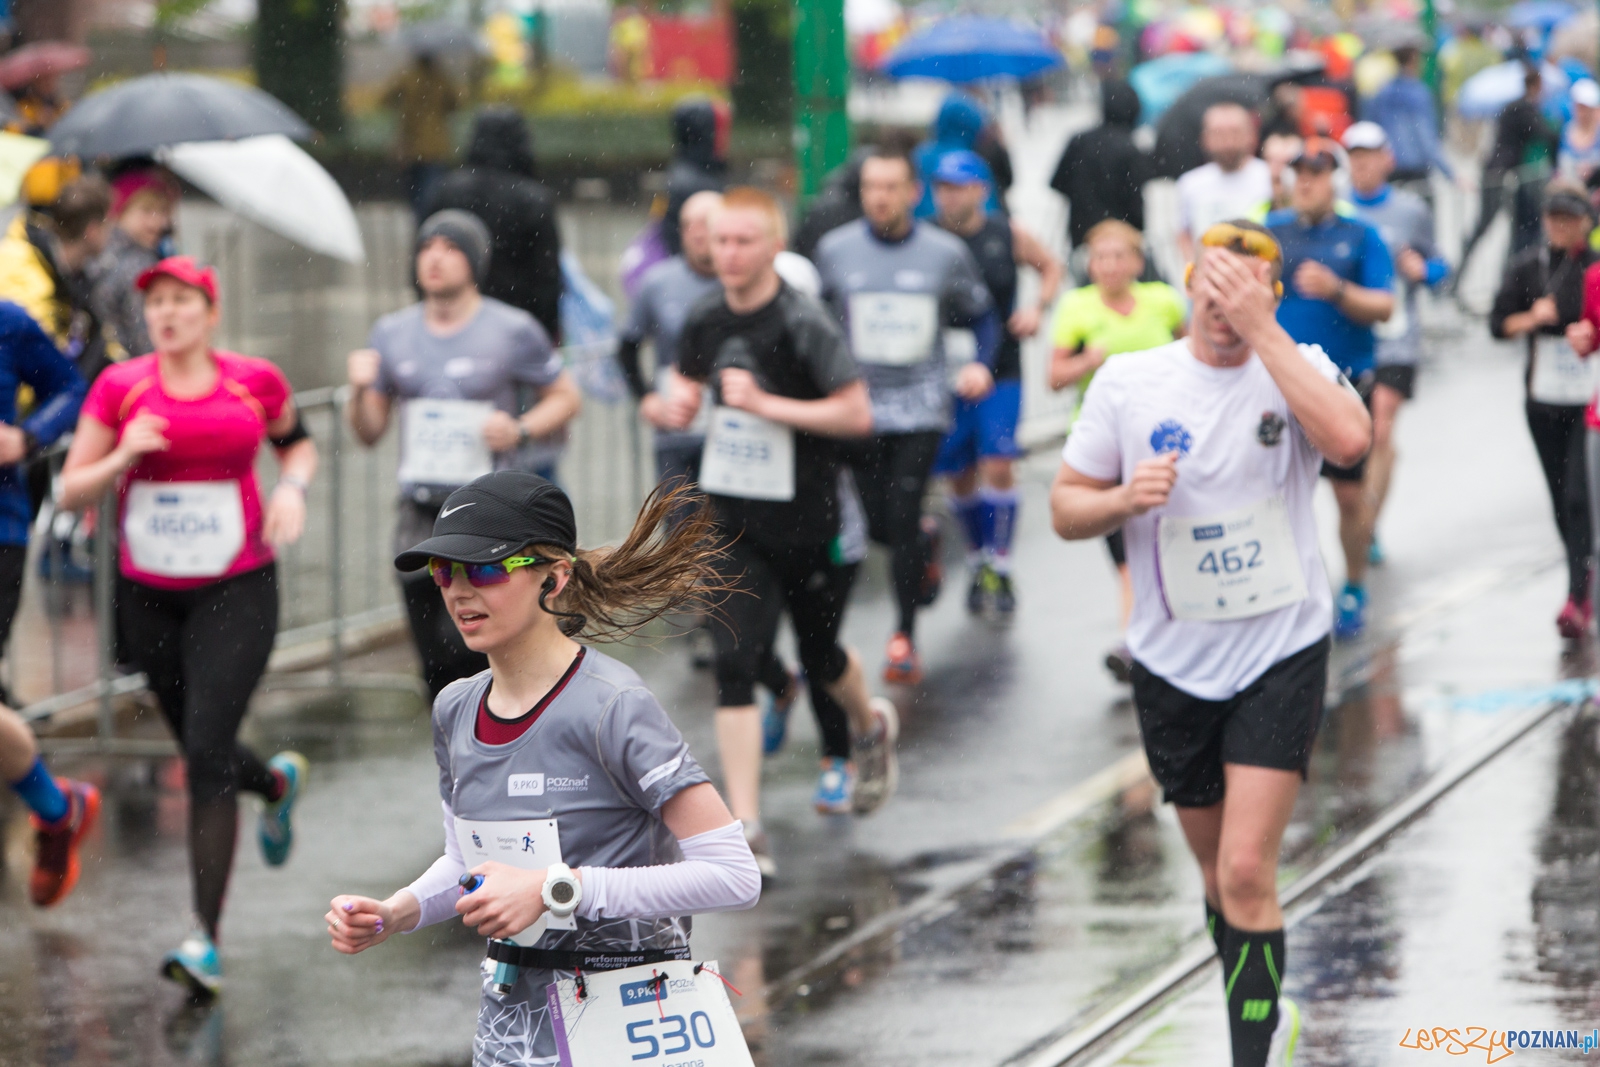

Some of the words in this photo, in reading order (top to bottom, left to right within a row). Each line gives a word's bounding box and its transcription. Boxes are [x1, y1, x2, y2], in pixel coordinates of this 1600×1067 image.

[1198, 540, 1264, 575] 462
[512, 780, 539, 790] 9.PKO
[584, 954, 645, 965] performance
[626, 1010, 716, 1061] 530
